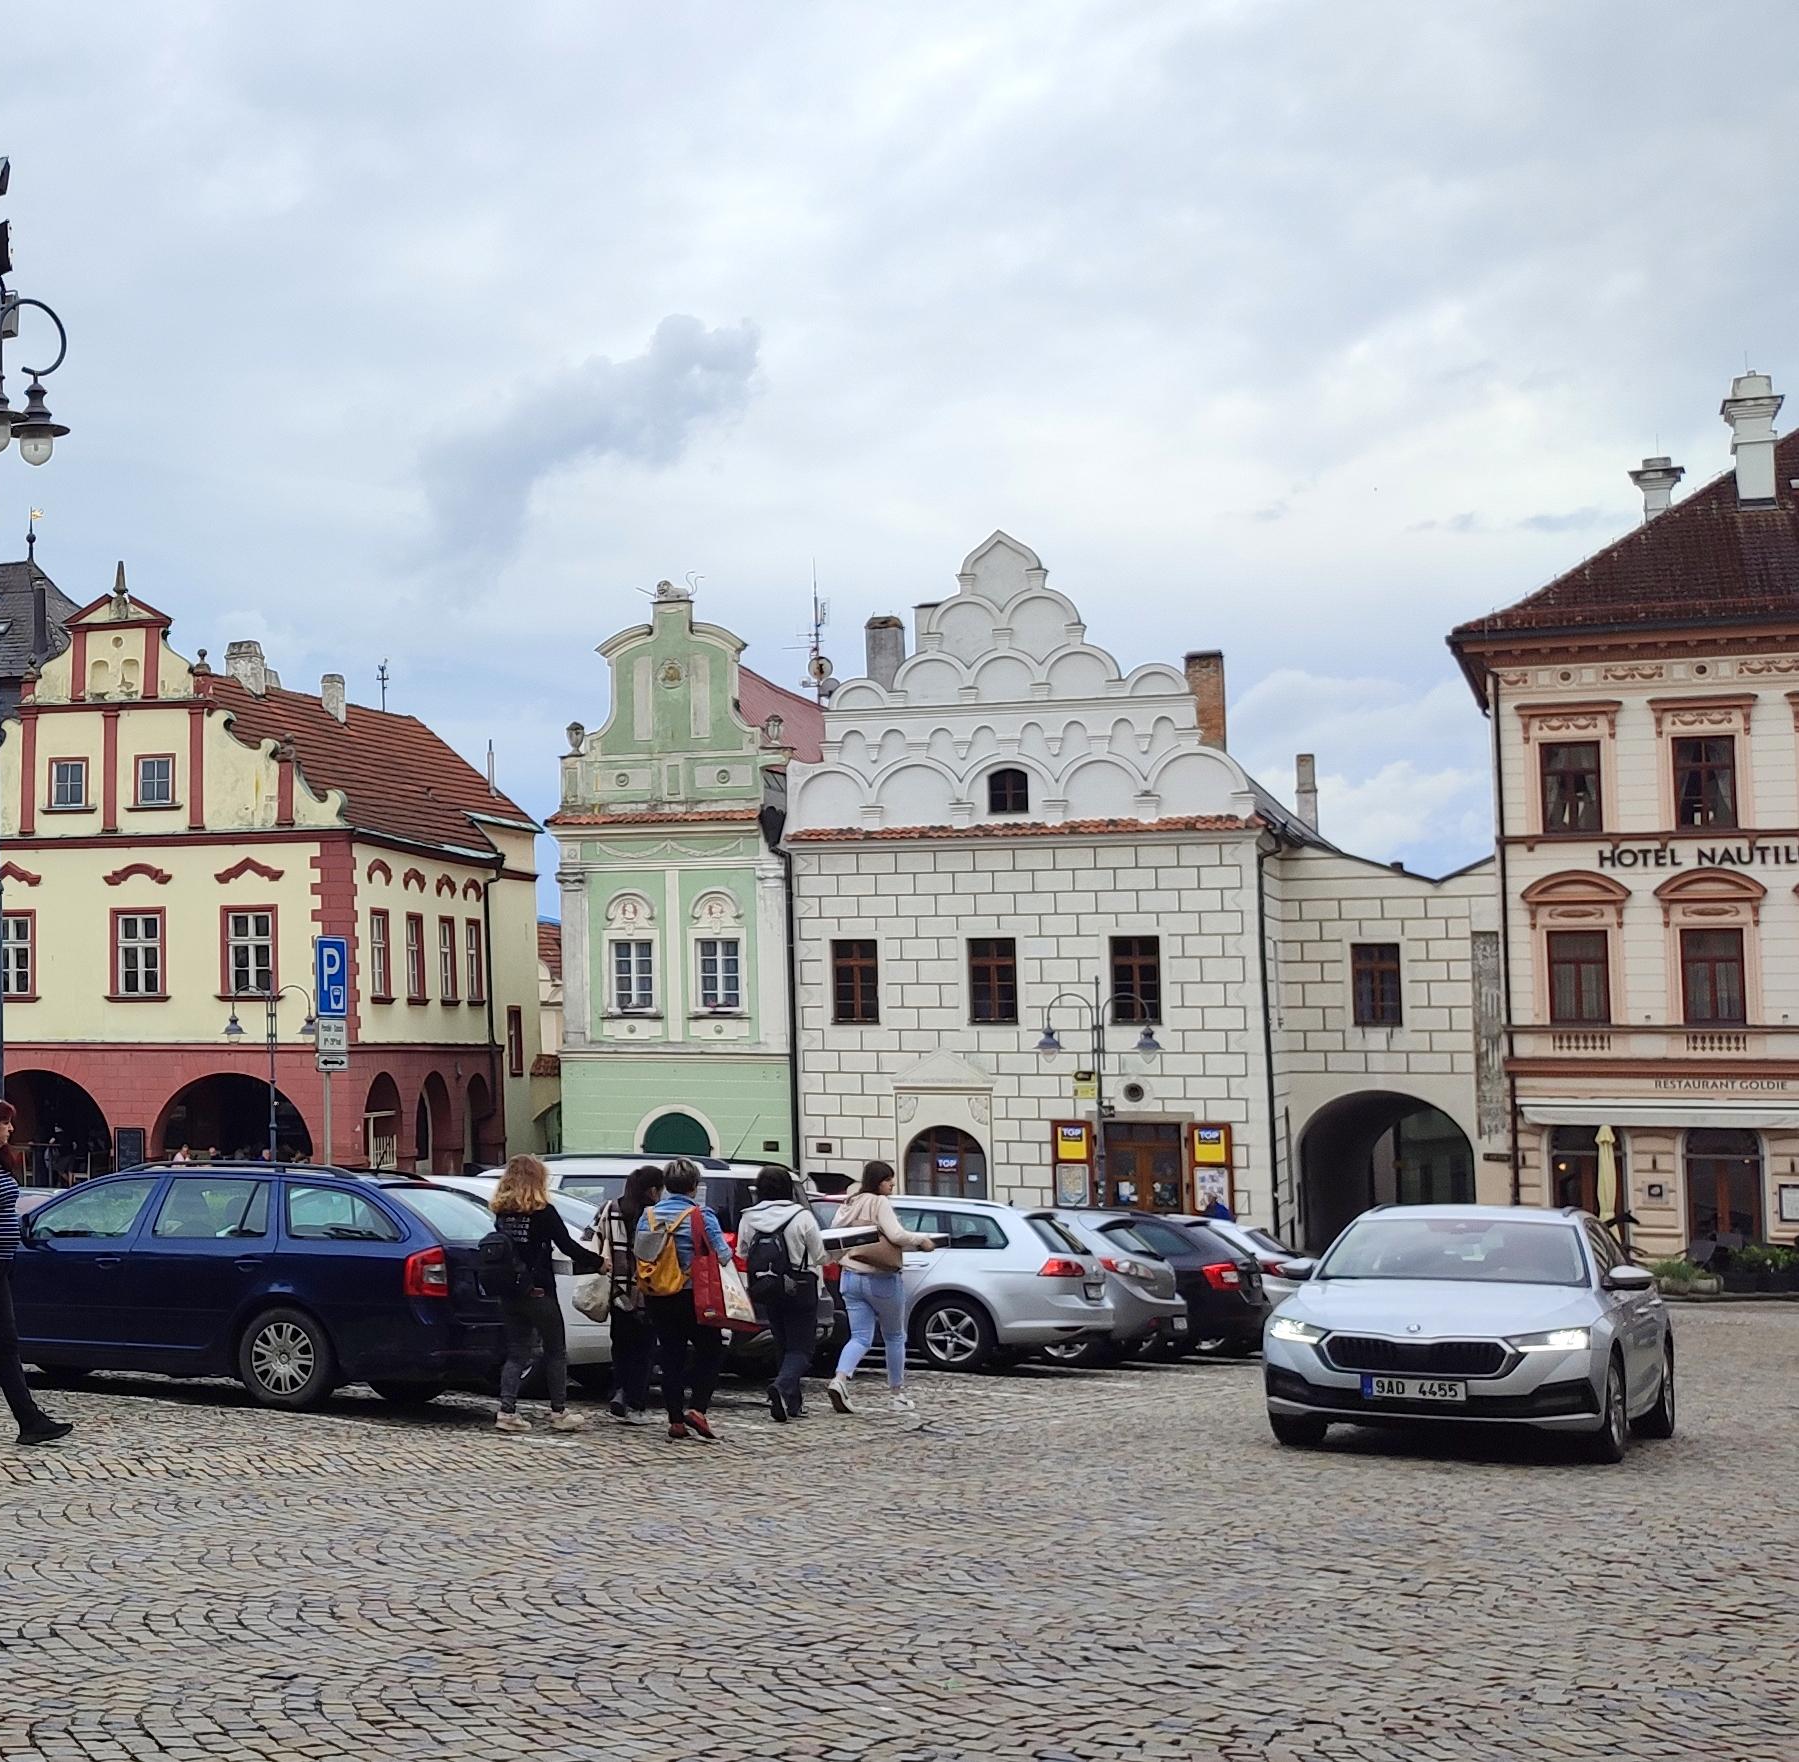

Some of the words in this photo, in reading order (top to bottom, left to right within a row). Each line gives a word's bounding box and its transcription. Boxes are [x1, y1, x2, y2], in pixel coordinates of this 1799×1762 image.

[1599, 848, 1682, 868] HOTEL
[1697, 845, 1799, 866] NAUTIL
[323, 948, 340, 991] P
[1654, 1080, 1737, 1090] RESTAURANT
[1739, 1080, 1788, 1090] GOLDIE
[1062, 1128, 1081, 1137] TOP
[1199, 1130, 1219, 1139] TOP
[937, 1159, 957, 1168] TOP
[1418, 1382, 1458, 1398] 4455
